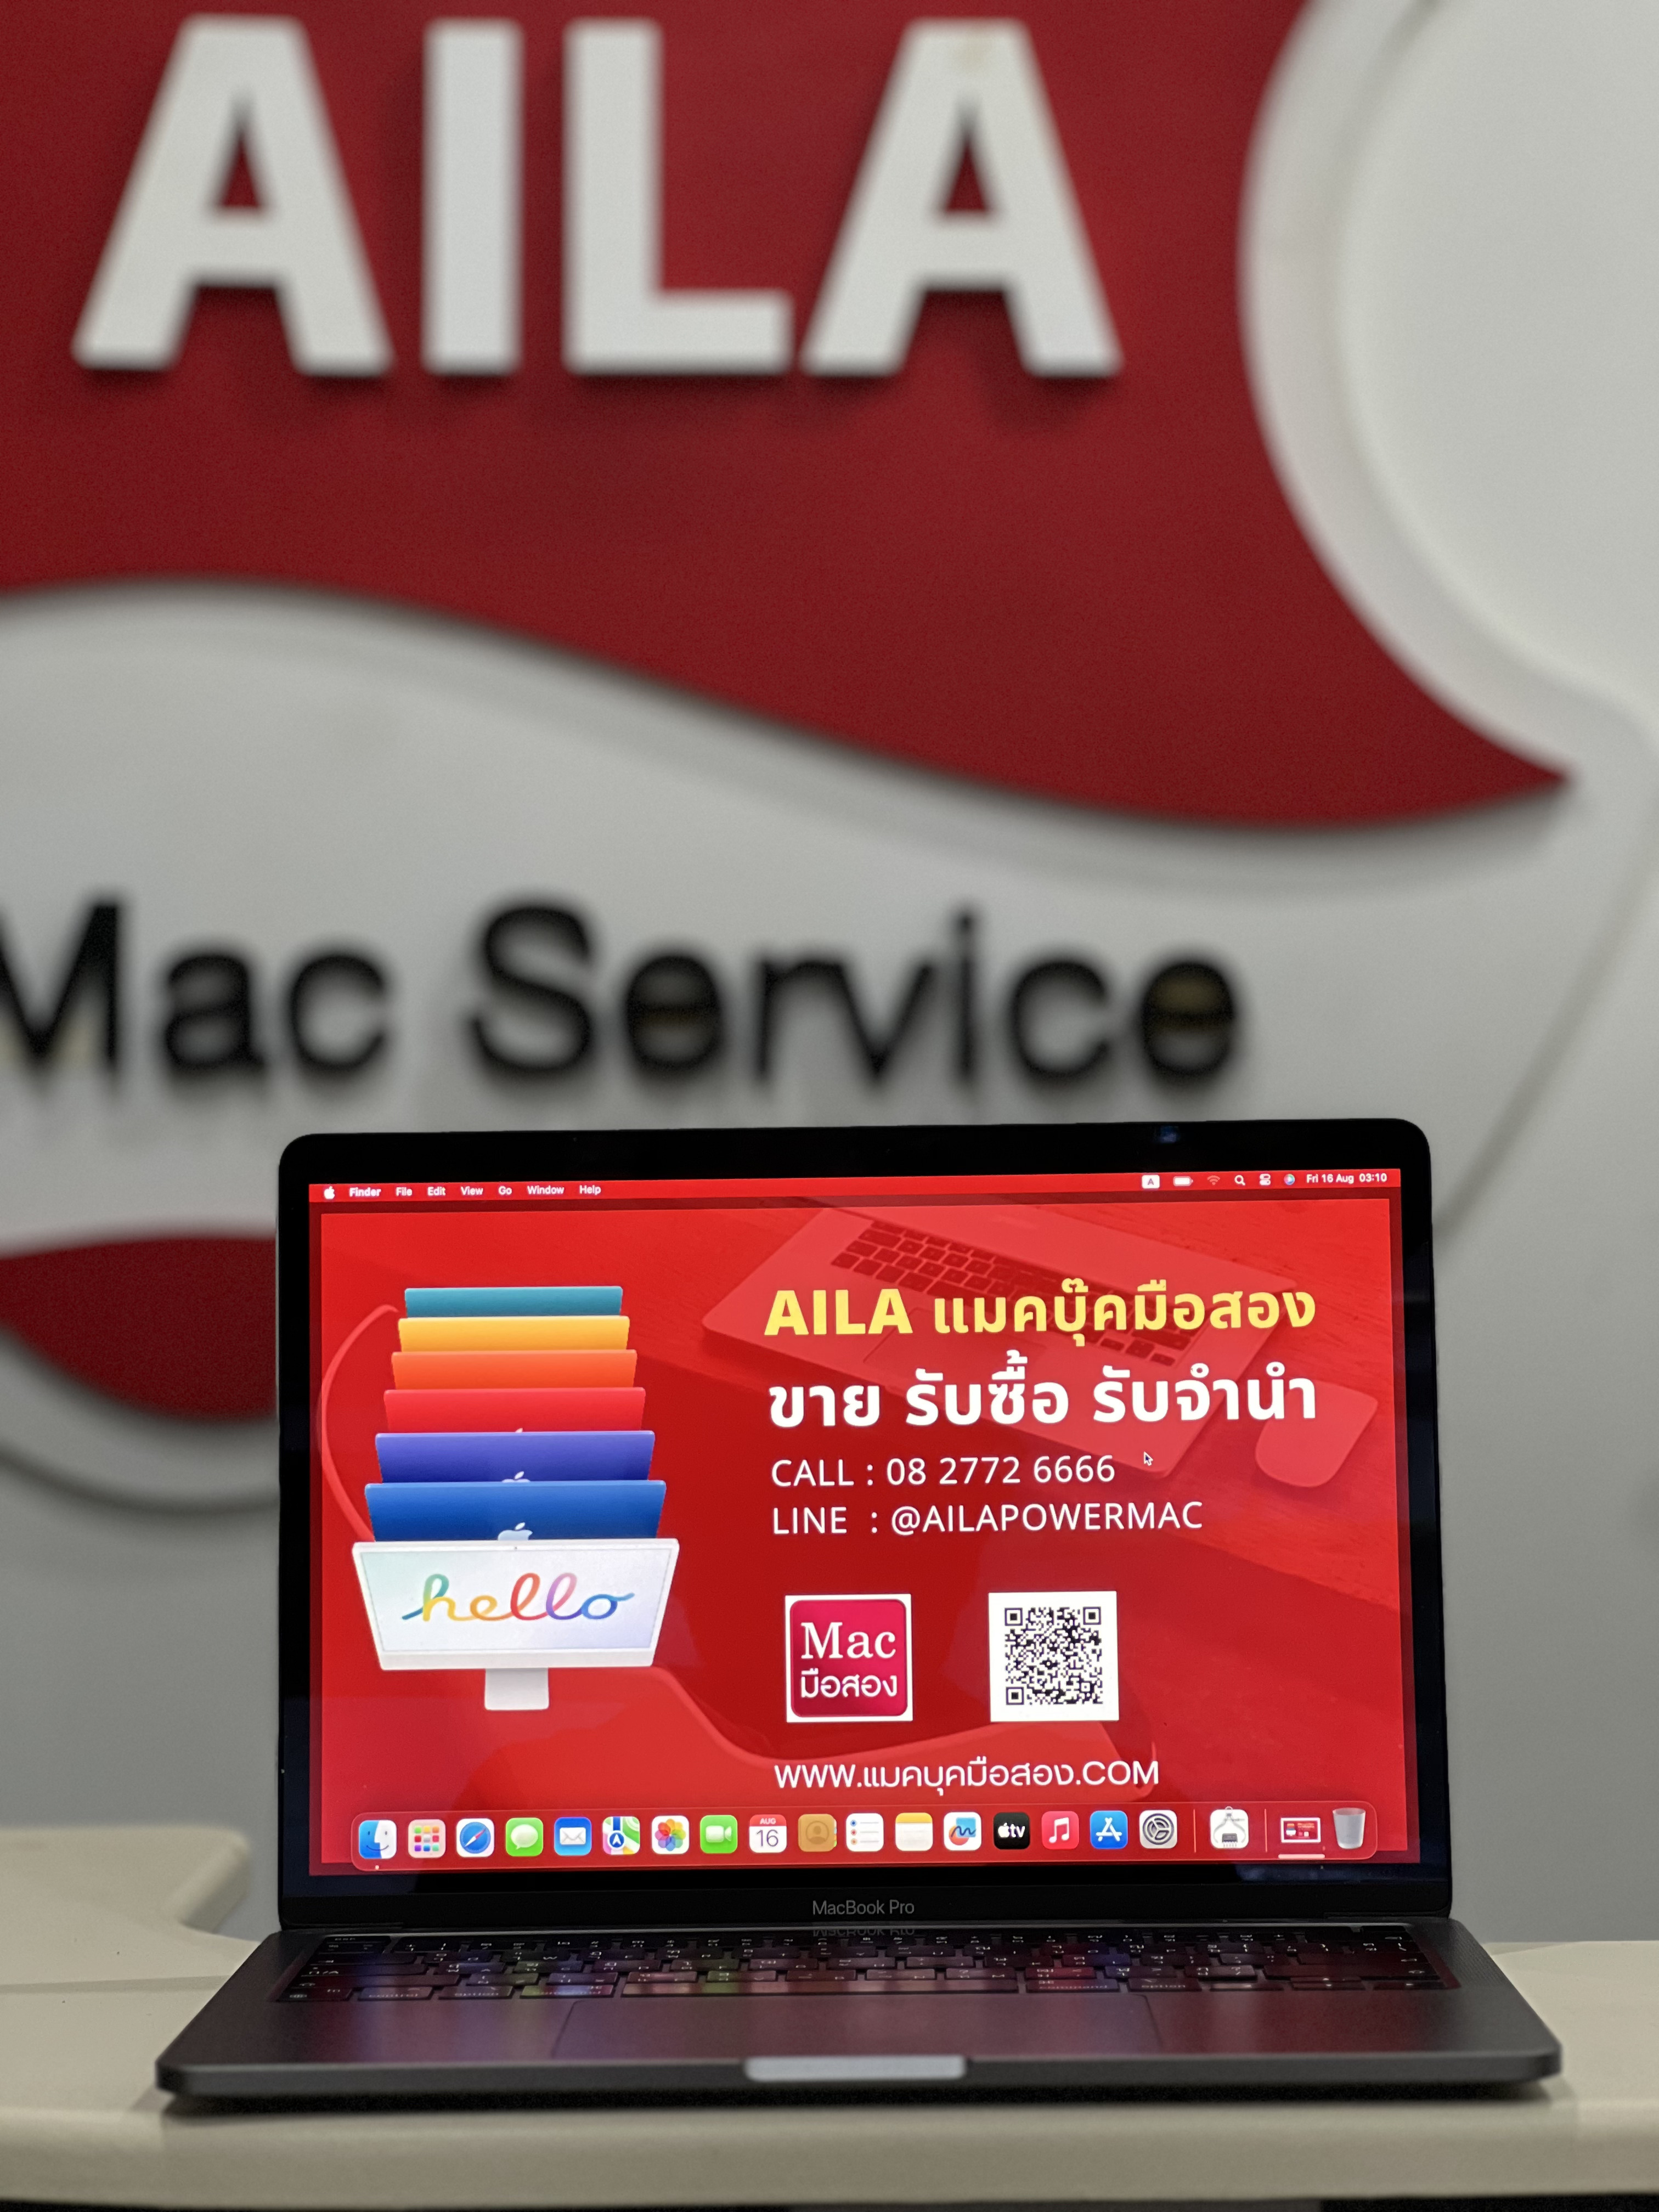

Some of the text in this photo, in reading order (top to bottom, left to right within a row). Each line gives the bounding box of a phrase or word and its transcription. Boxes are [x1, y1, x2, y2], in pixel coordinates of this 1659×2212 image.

[74, 14, 1124, 377] AILA
[0, 892, 1240, 1083] Mac Service
[349, 1185, 601, 1197] Finder File Edit View Go Window Help
[1306, 1172, 1387, 1184] Fri 16 Aug 03:10
[765, 1278, 1316, 1346] AILA แมคบุ๊คมือสอง
[769, 1350, 1316, 1427] ขาย รับซื้อ รับจำนำ
[772, 1459, 854, 1486] CALL
[887, 1458, 926, 1485] 08
[940, 1457, 1020, 1484] 2772
[1034, 1455, 1114, 1482] 6666
[774, 1507, 847, 1534] LINE
[892, 1502, 1202, 1535] @AILAPOWERMAC
[403, 1573, 634, 1622] hello
[801, 1622, 895, 1658] Mac
[801, 1668, 897, 1697] มือสอง
[774, 1756, 1158, 1796] WWW.แมคบุคมือสอง.COM
[757, 1829, 778, 1847] 16
[1010, 1824, 1025, 1837] tv
[813, 1899, 915, 1915] MacBook Pro
